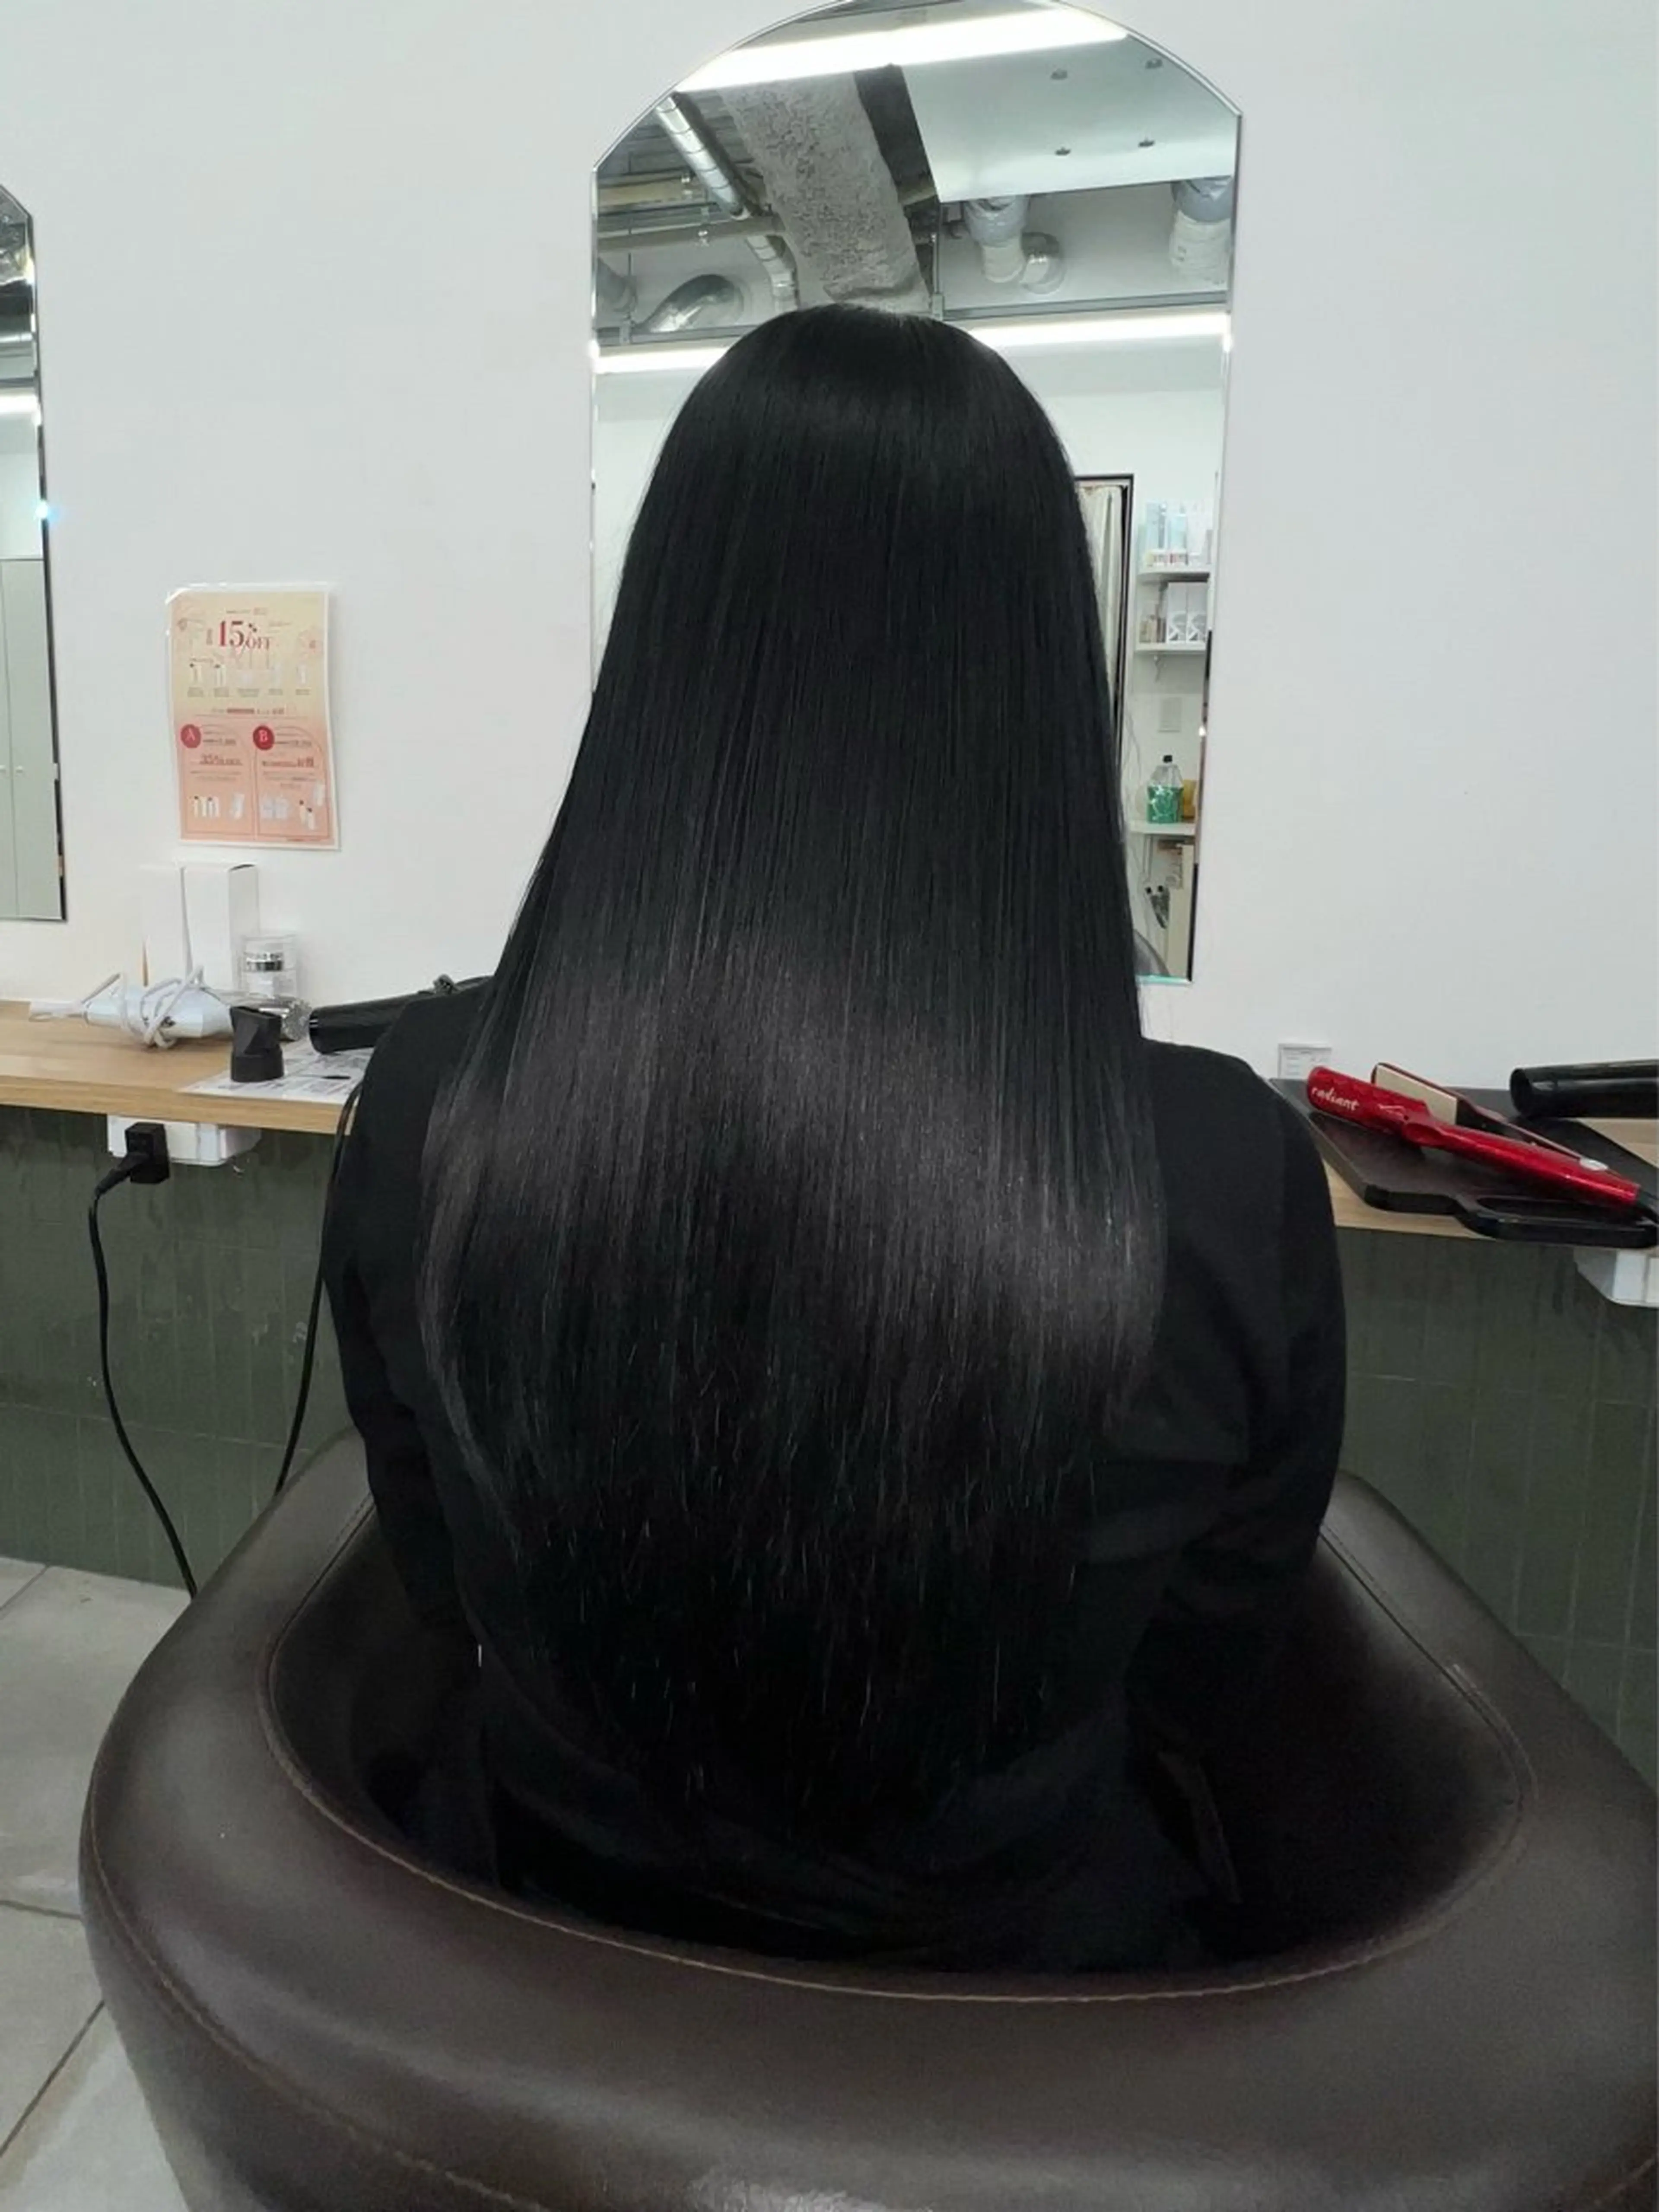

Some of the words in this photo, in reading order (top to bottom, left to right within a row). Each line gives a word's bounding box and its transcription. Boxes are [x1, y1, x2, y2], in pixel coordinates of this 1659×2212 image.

[185, 728, 196, 741] A
[259, 730, 268, 742] B
[1312, 1087, 1360, 1111] radiant
